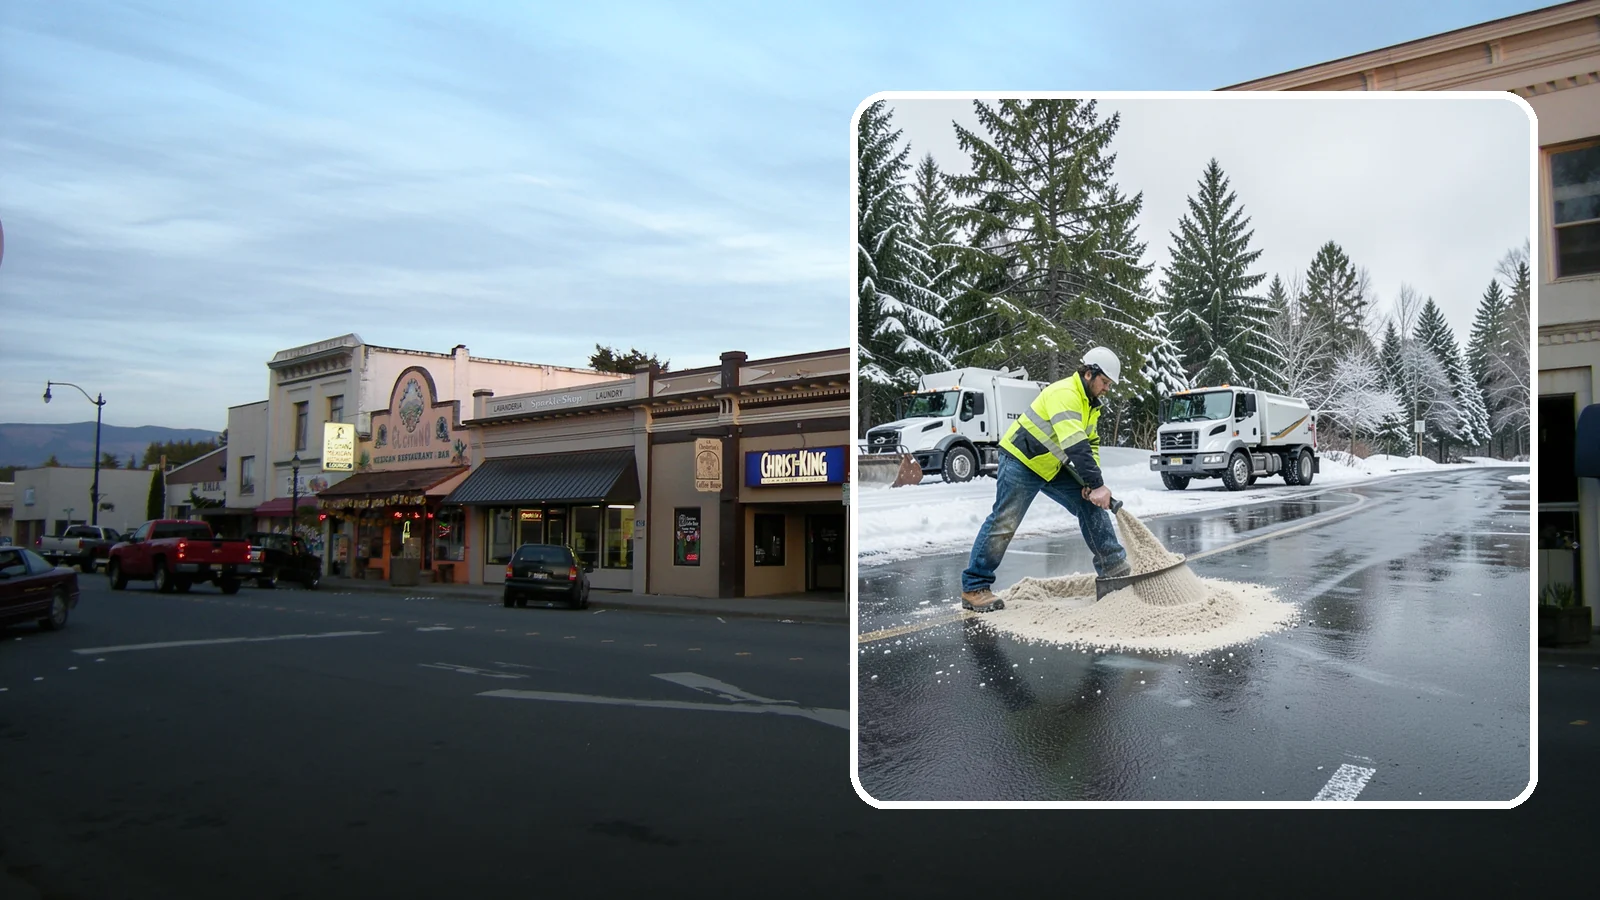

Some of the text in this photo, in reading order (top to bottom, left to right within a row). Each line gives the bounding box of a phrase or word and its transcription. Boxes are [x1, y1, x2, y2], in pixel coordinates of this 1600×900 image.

[530, 394, 582, 409] Sparkle Shop
[595, 389, 623, 400] LAUNDRY
[493, 402, 522, 412] LAVANDERIA
[373, 455, 396, 464] MEXICAN
[397, 451, 433, 462] RESTAURANT
[438, 450, 450, 458] BAR
[760, 450, 827, 478] CHRIST KING
